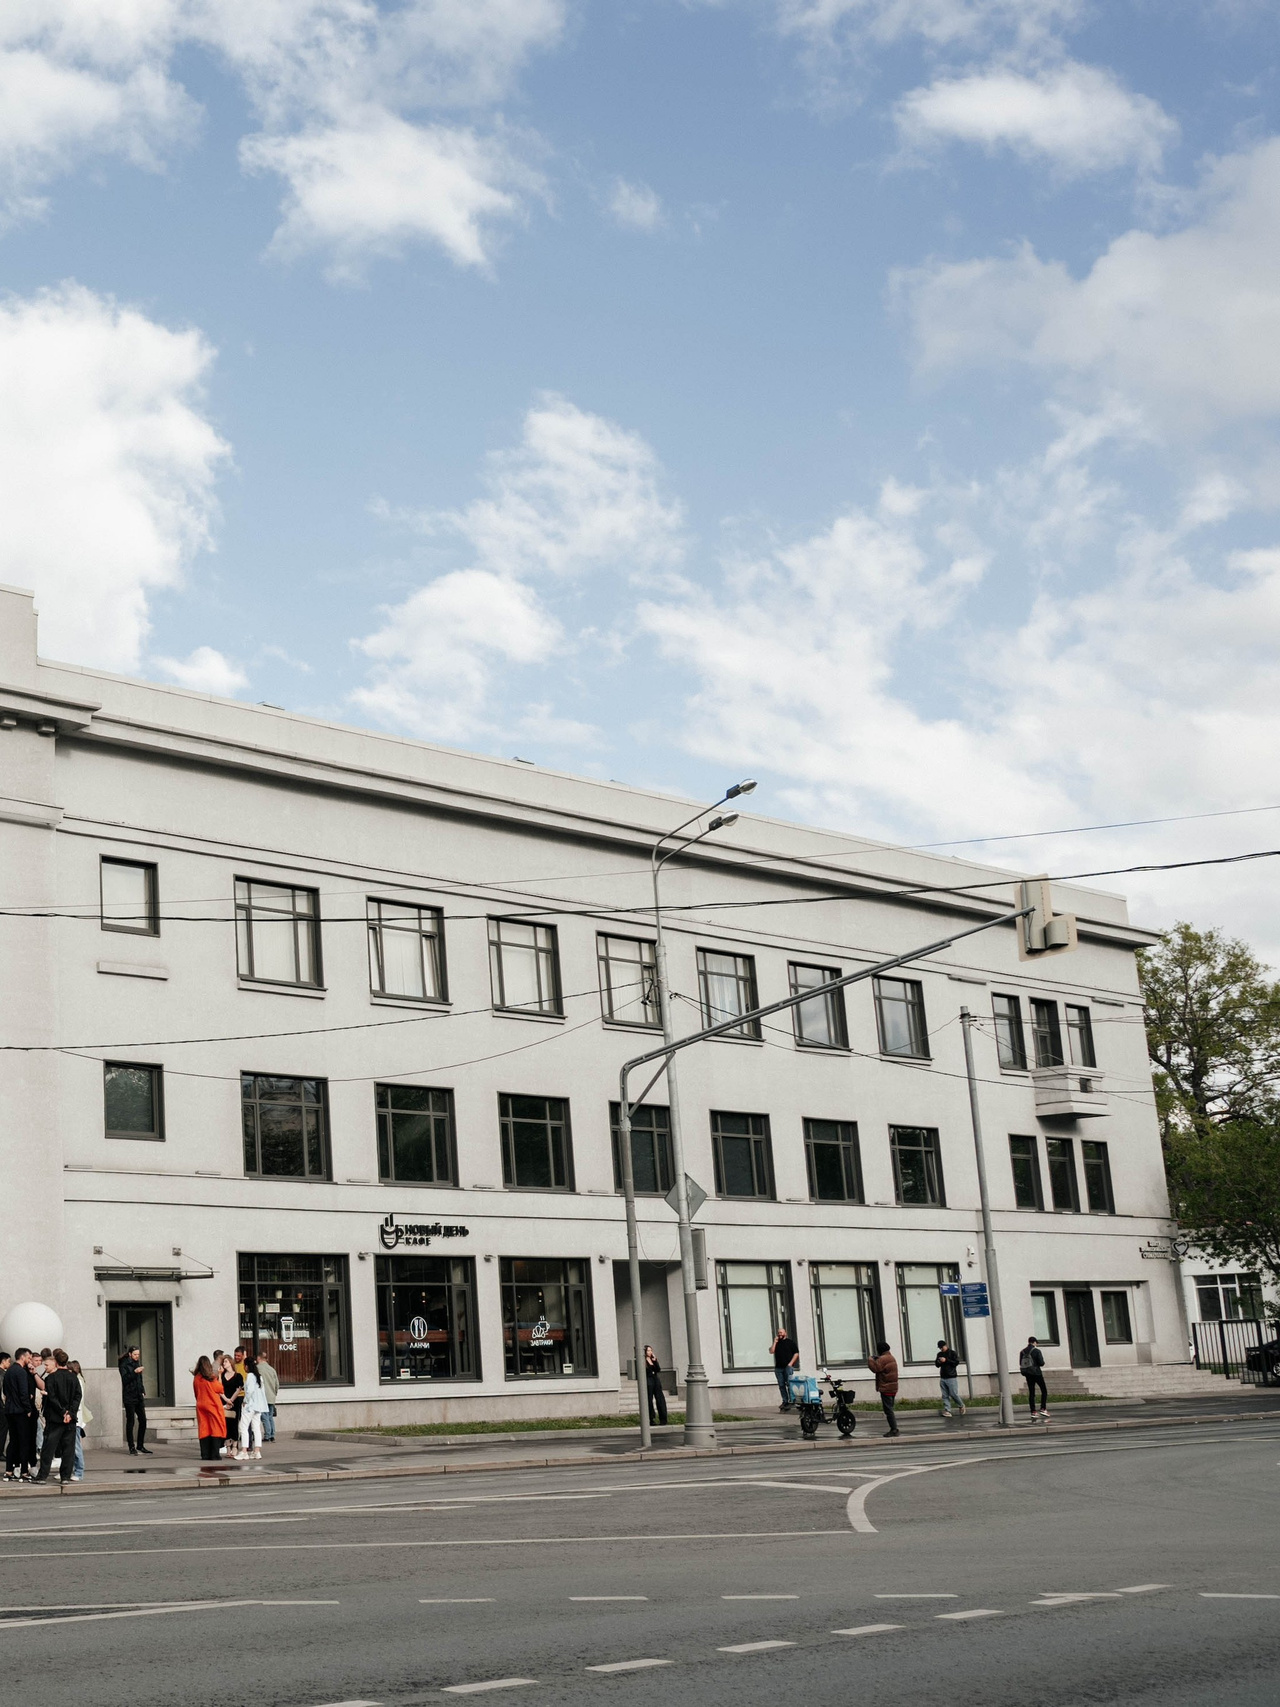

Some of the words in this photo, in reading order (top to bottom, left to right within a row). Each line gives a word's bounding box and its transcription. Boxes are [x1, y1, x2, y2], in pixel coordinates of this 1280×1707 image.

[404, 1222, 442, 1237] НОВЫЙ
[442, 1225, 470, 1239] ДЕНЬ
[404, 1237, 432, 1247] КАФЕ
[279, 1343, 298, 1351] КОФЕ
